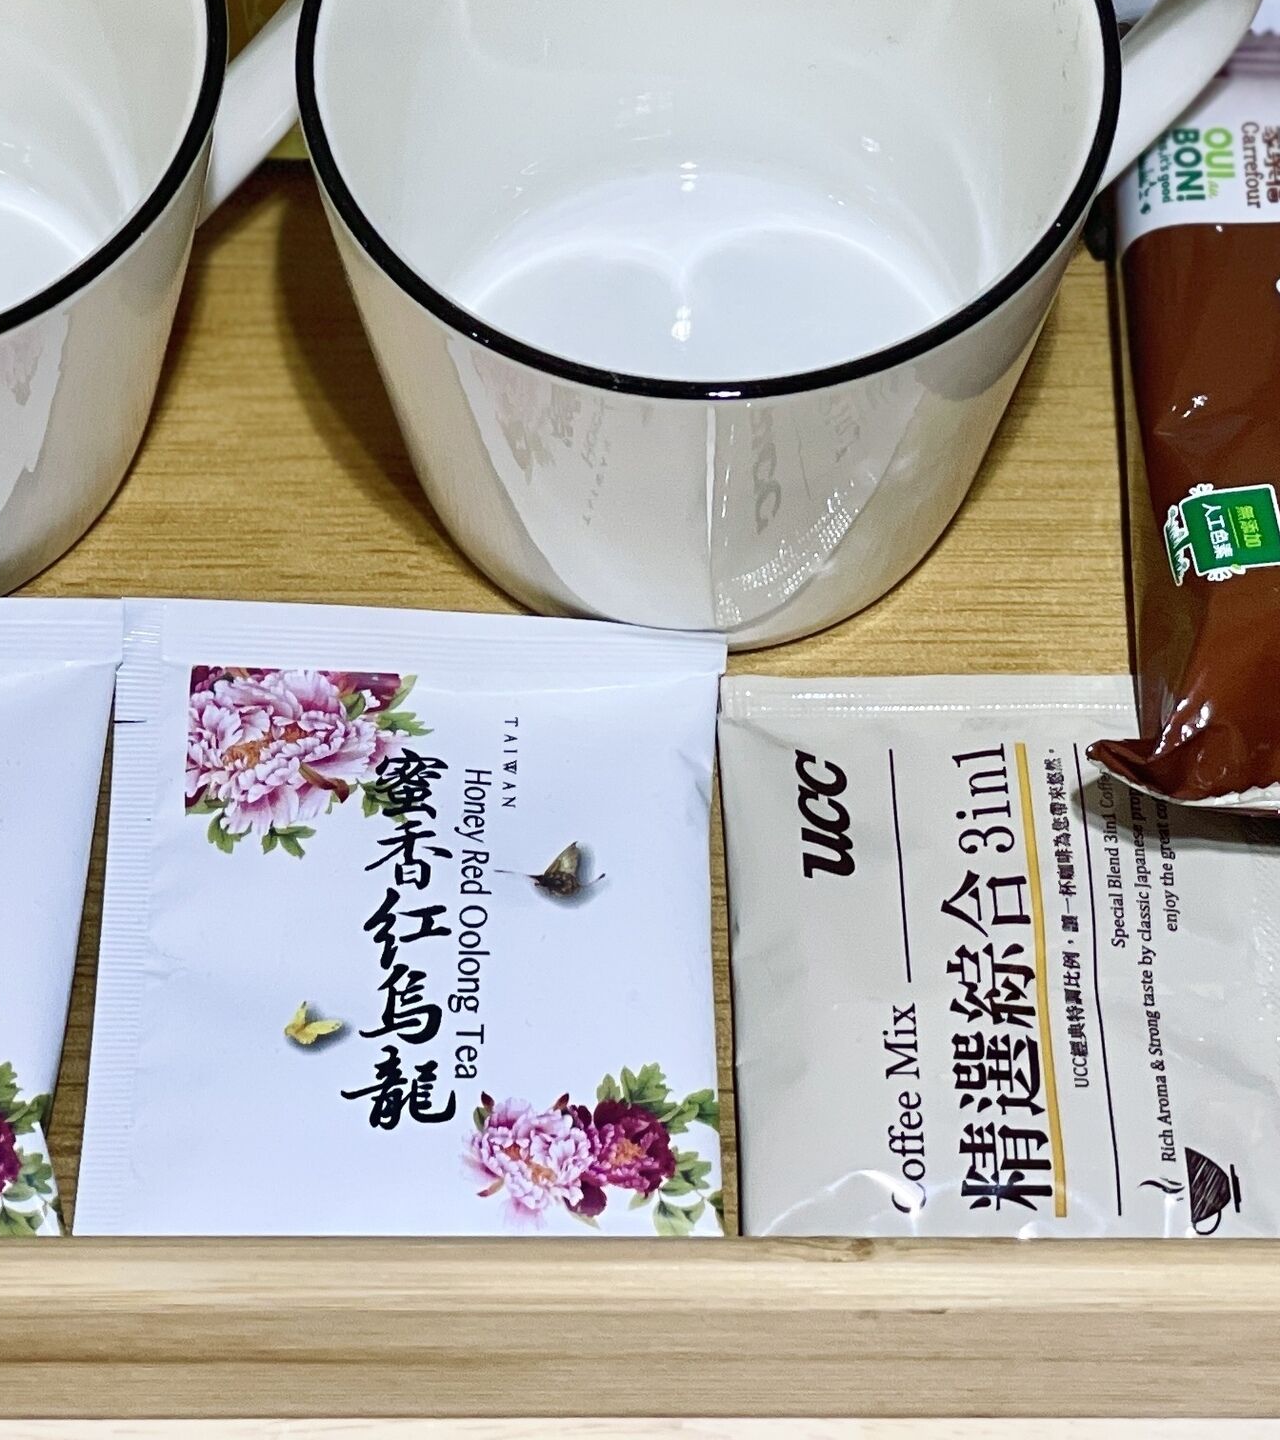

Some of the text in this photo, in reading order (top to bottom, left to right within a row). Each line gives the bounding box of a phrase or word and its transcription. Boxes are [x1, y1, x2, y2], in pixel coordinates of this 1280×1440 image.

[1172, 127, 1206, 203] BON!
[1203, 126, 1236, 179] OUI
[1241, 121, 1262, 209] Carrefour
[1200, 502, 1234, 560] 人工色素
[503, 716, 519, 810] TAIWAN
[1102, 812, 1119, 844] 3in1
[1156, 821, 1177, 860] great
[1103, 846, 1123, 890] Blend
[1131, 822, 1152, 890] Japanese
[1158, 862, 1175, 885] the
[447, 767, 494, 1081] Honey Red Oolong Tea
[1107, 888, 1130, 949] Special
[1134, 891, 1154, 942] classic
[1160, 888, 1182, 933] enjoy
[940, 741, 1054, 1213] 精選綜合 3in1
[1137, 947, 1158, 966] by
[1137, 969, 1156, 1007] taste
[1142, 1009, 1163, 1057] Strong
[1150, 1059, 1166, 1073] &
[884, 1002, 928, 1215] Coffee Mix
[1154, 1074, 1174, 1127] Aroma
[1158, 1127, 1177, 1163] Rich
